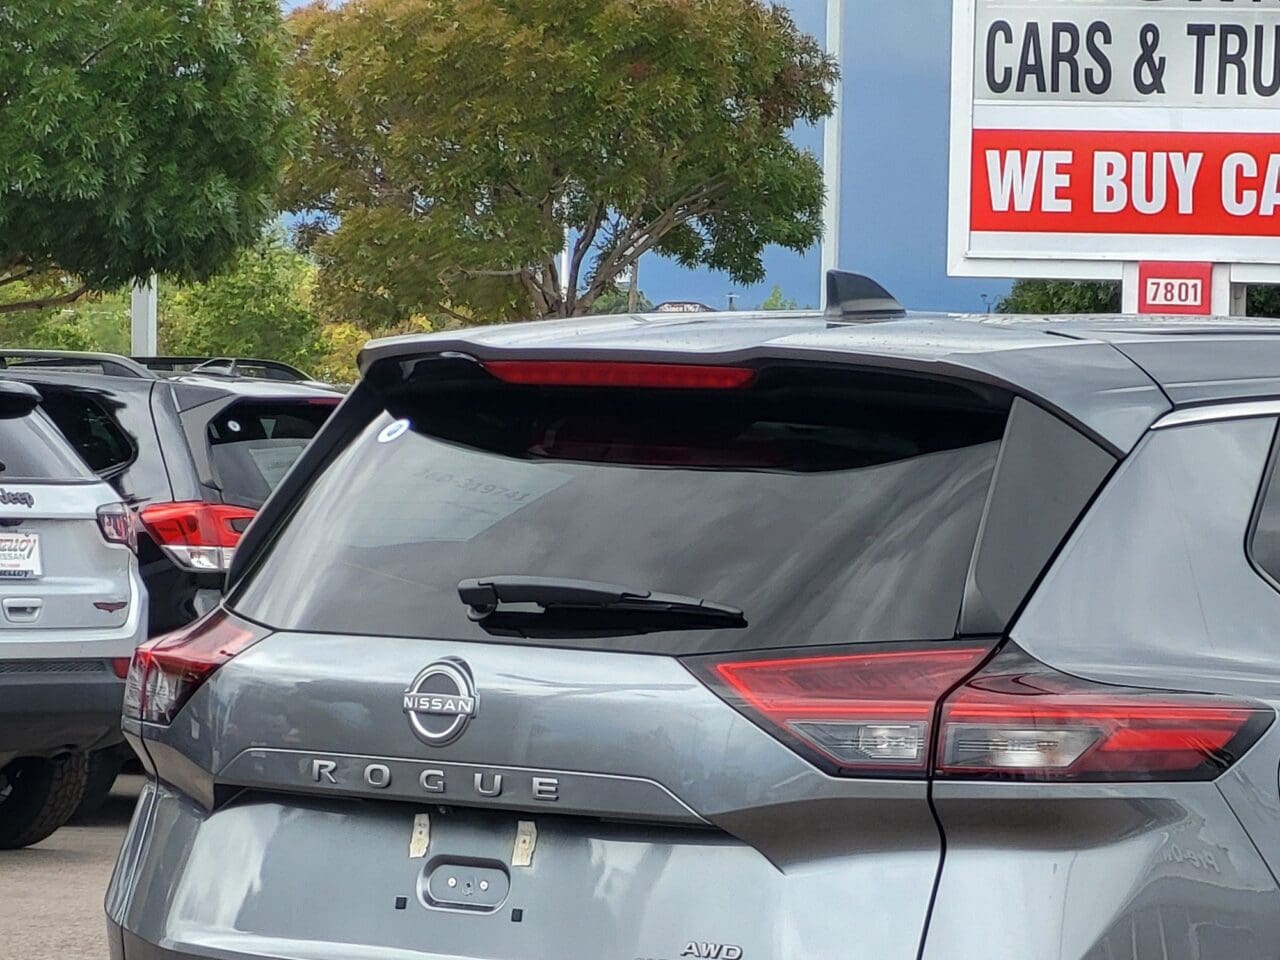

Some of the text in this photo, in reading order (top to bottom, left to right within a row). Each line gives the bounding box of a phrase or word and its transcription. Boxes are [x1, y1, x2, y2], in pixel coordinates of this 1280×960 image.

[986, 20, 1112, 94] CARS
[1133, 23, 1166, 94] &
[984, 150, 1073, 213] WE
[1093, 151, 1203, 214] BUY
[1149, 282, 1198, 302] 7801
[403, 695, 472, 713] NISSAN
[312, 759, 559, 801] ROGUE
[680, 941, 743, 960] AWD
